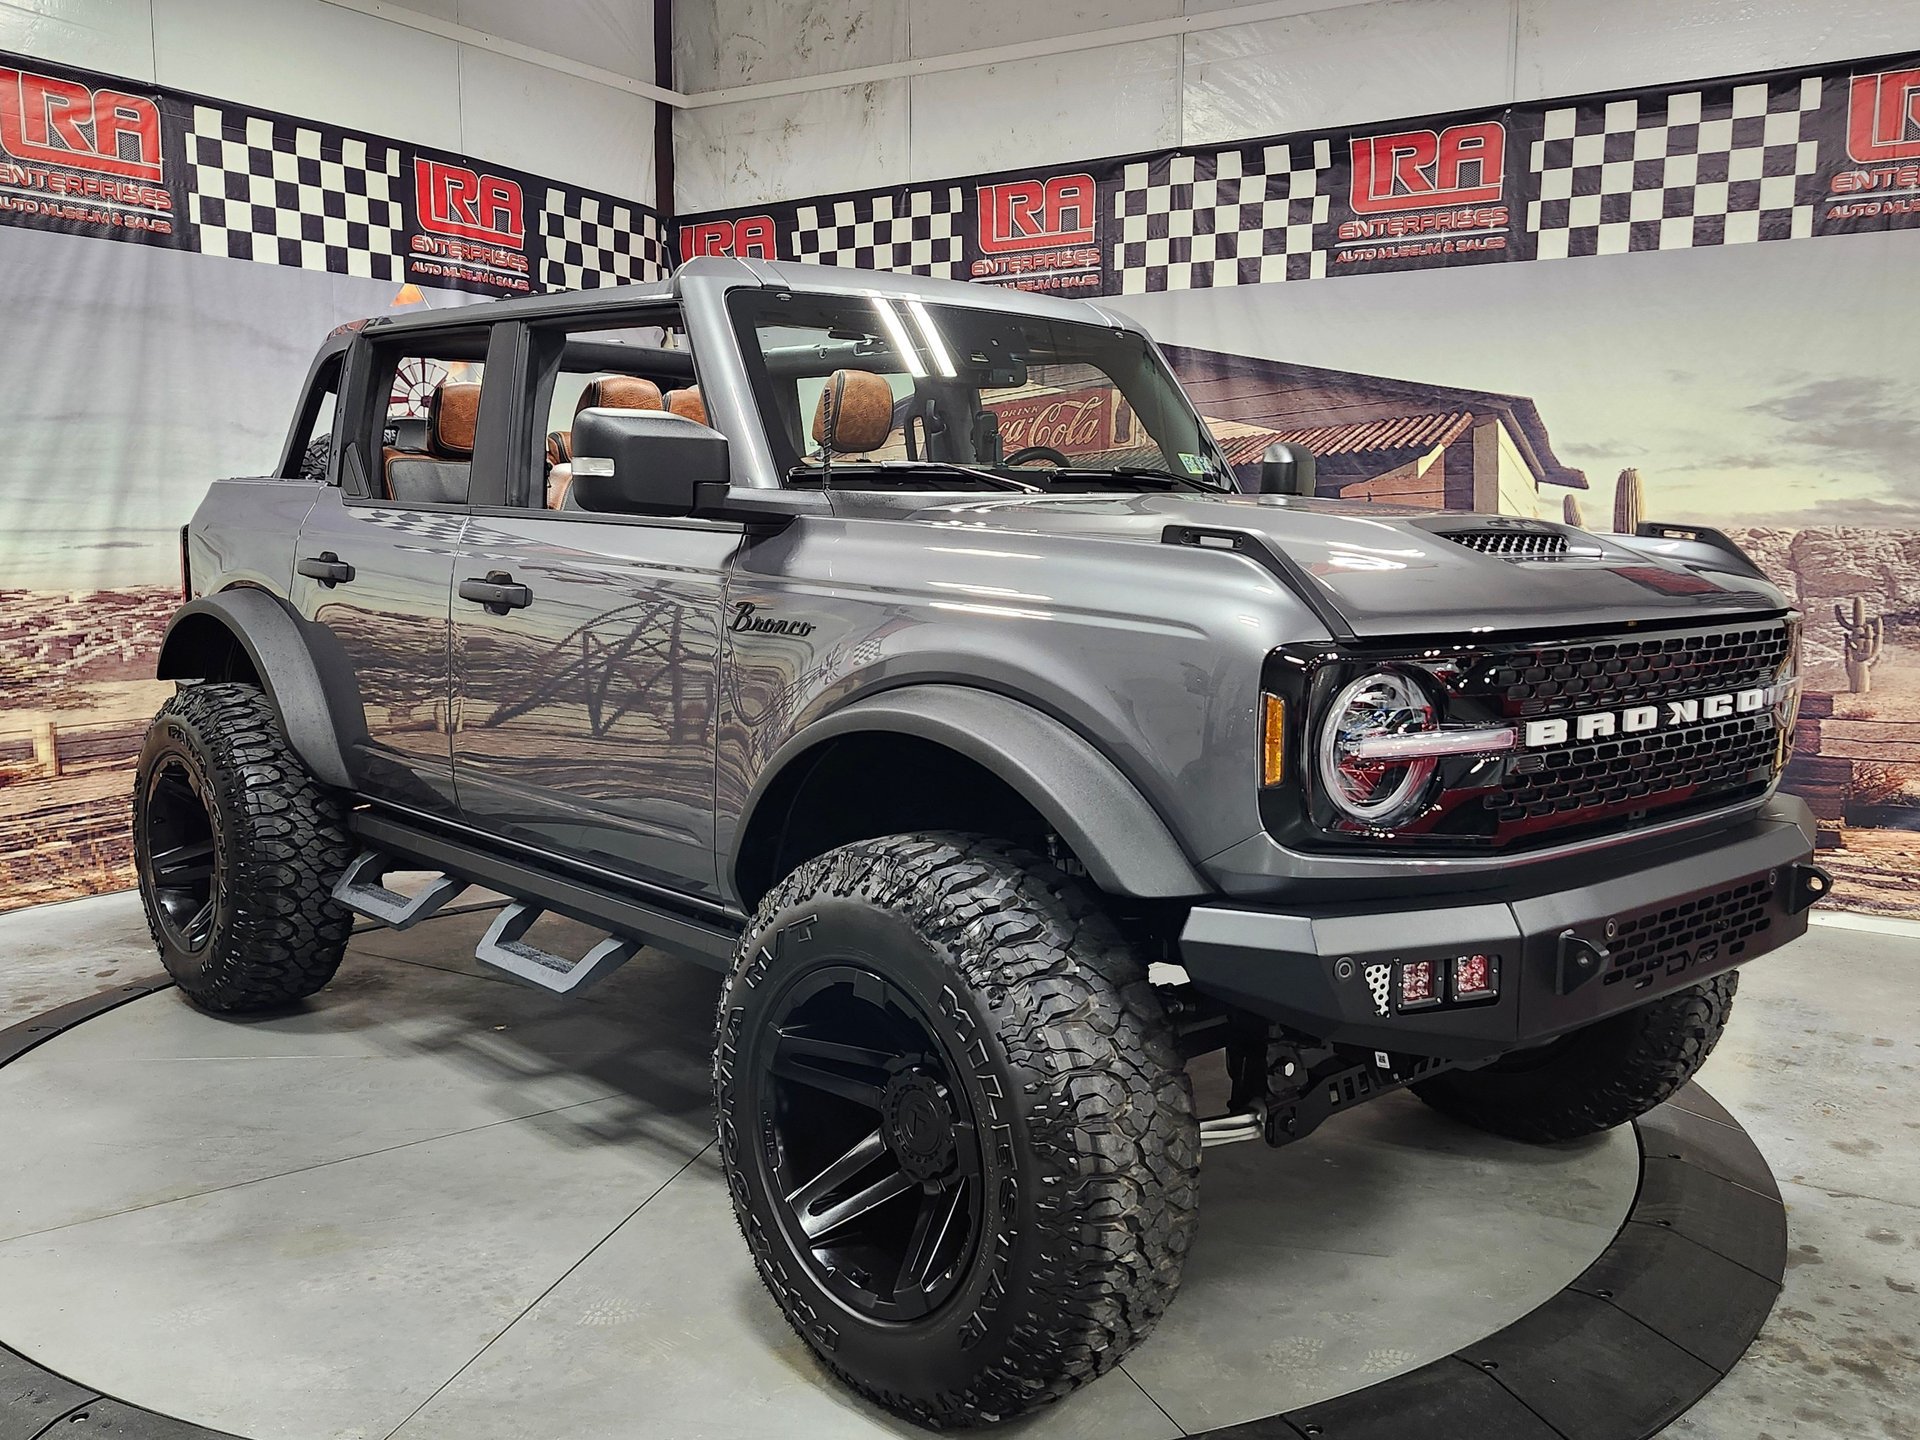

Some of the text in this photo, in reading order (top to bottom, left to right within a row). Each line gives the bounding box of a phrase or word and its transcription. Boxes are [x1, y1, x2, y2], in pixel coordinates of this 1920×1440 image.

[1350, 120, 1507, 215] LRA
[40, 202, 110, 224] MUSEUM
[112, 213, 124, 226] &
[124, 215, 172, 234] SALES
[414, 156, 526, 250] LRA
[976, 172, 1097, 255] LRA
[1826, 202, 1881, 219] AUTO
[1338, 206, 1509, 240] ENTERPRISES
[411, 234, 529, 271] ENTERPRISES
[971, 247, 1100, 276] ENTERPRISES
[1335, 236, 1506, 264] AUTO MUSEUM & SALES
[411, 261, 442, 274] AUTO
[496, 275, 530, 291] SALES
[1052, 278, 1060, 289] &
[1061, 274, 1099, 288] SALES
[1001, 405, 1040, 418] DRINK
[727, 601, 816, 637] Bronco
[1525, 688, 1764, 747] BRONCO
